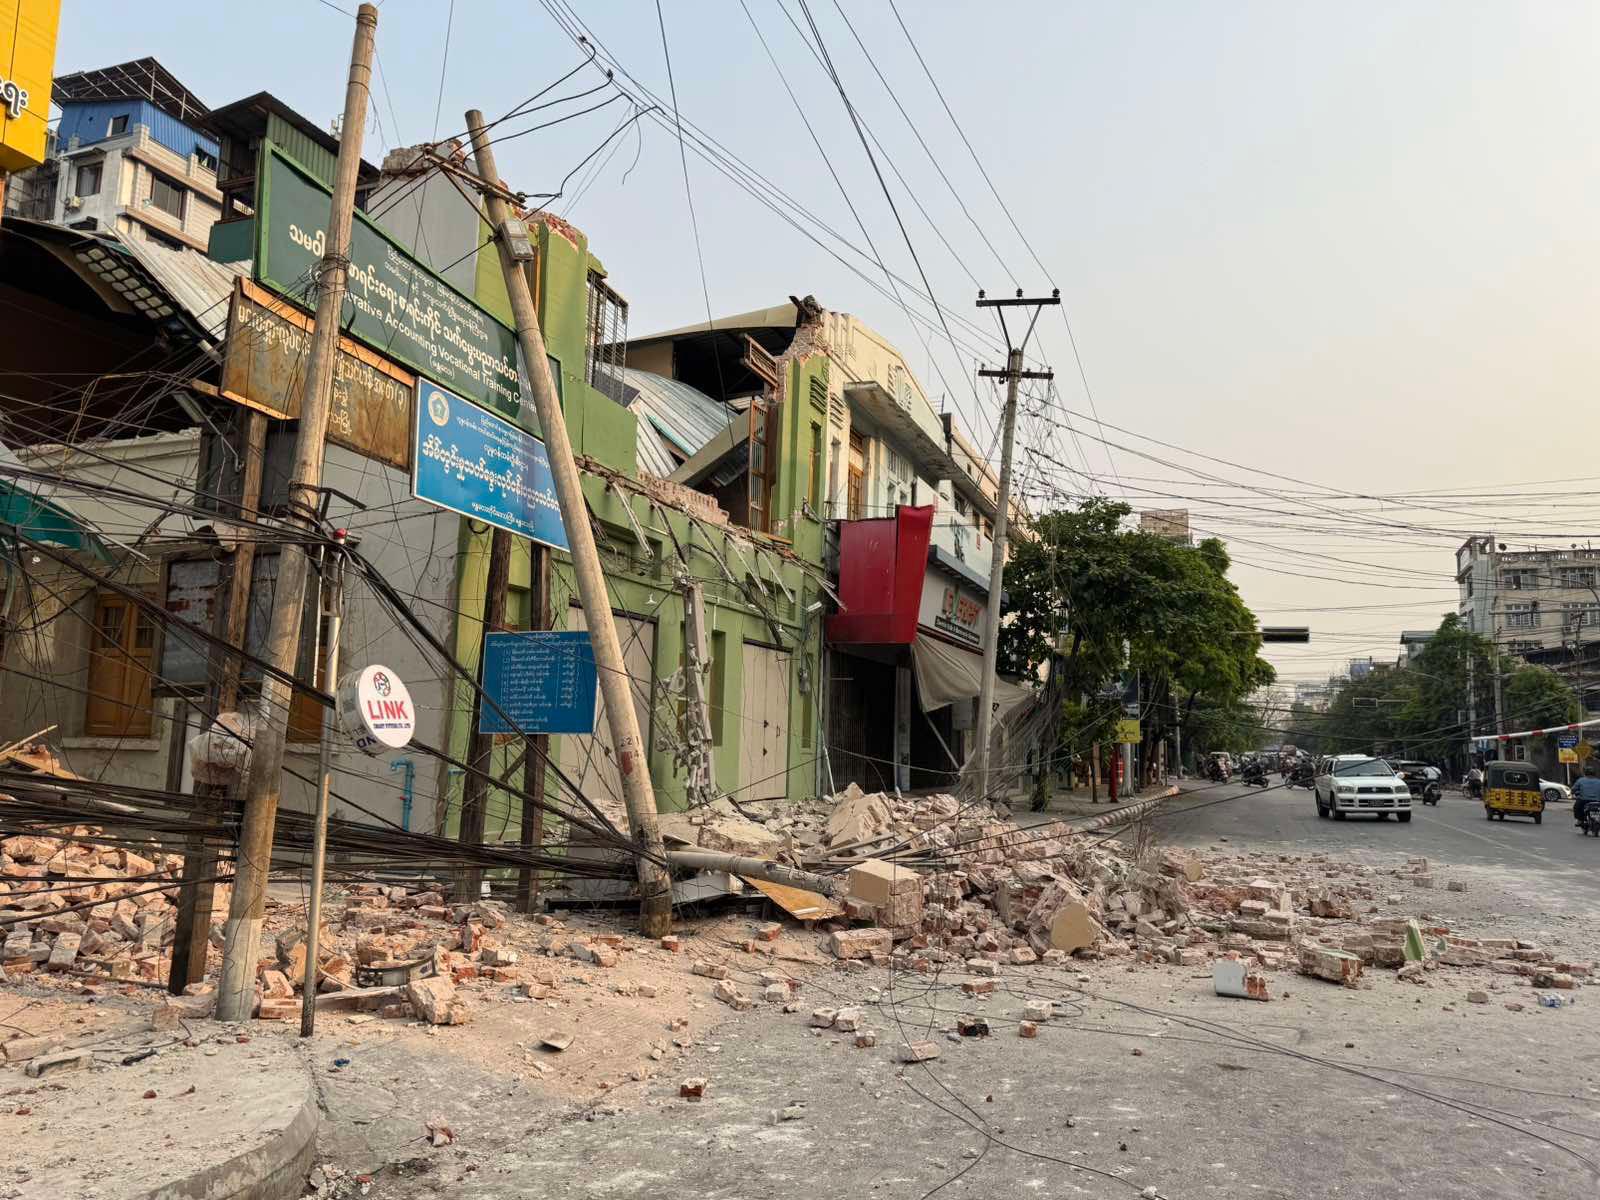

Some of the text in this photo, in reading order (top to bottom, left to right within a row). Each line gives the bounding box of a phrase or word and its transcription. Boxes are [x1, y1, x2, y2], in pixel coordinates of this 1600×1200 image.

[289, 224, 326, 259] သမဝါ
[384, 312, 437, 357] Accounting
[438, 345, 480, 381] Vocational
[481, 371, 512, 402] Training
[367, 700, 409, 721] LINK
